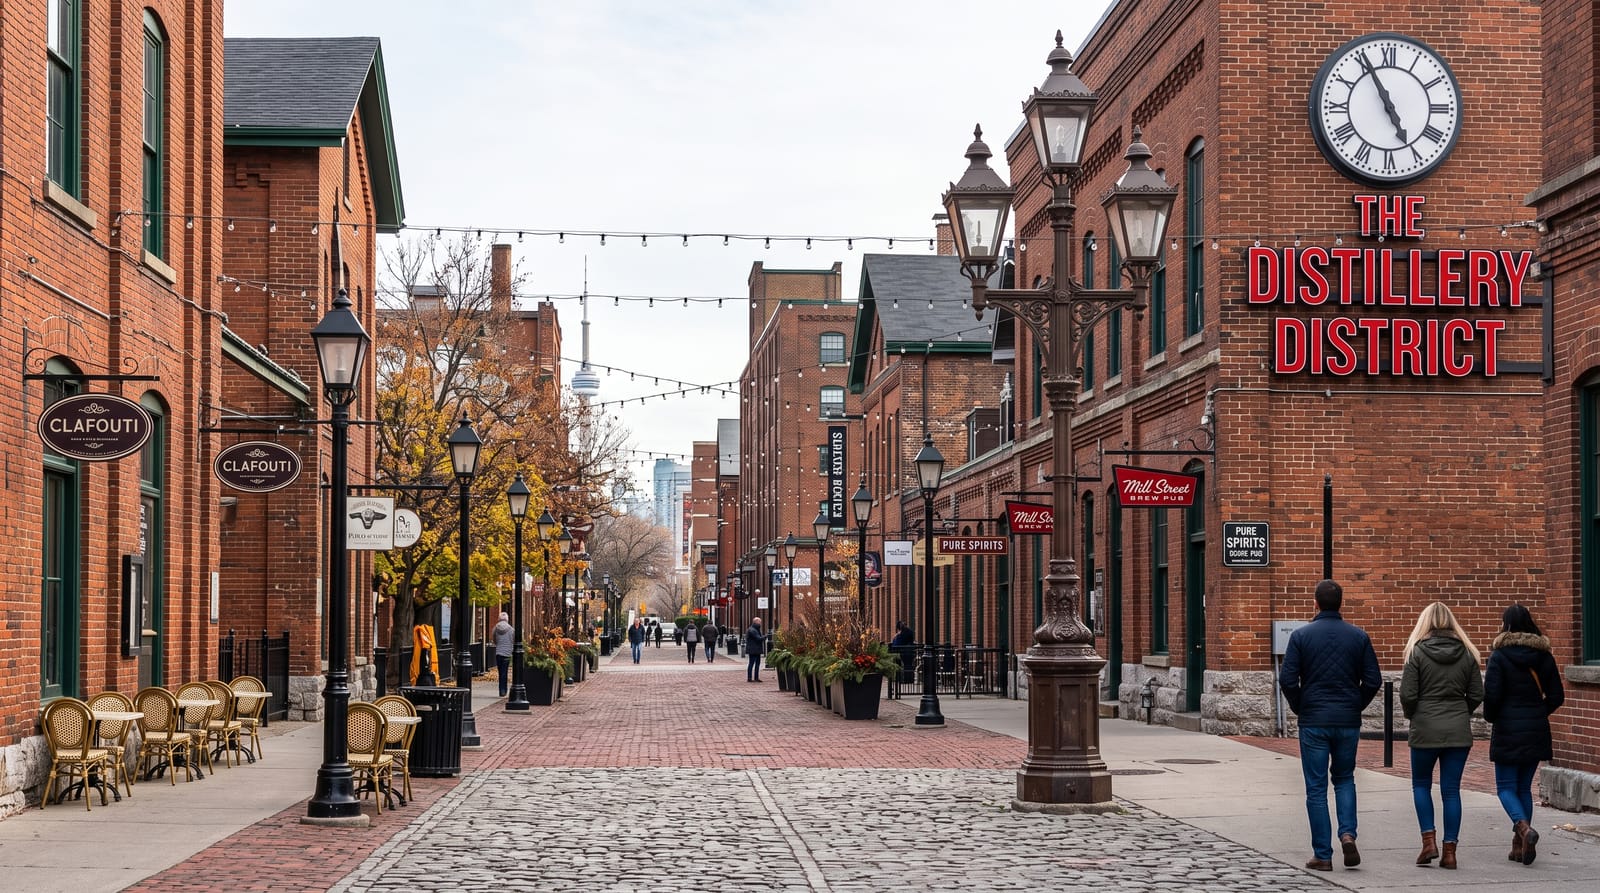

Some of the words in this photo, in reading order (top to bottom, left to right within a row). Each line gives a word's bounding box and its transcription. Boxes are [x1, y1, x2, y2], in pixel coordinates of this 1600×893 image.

[1381, 47, 1396, 67] XII
[1408, 55, 1420, 72] I
[1335, 74, 1355, 89] X
[1424, 76, 1442, 90] II
[1329, 101, 1348, 113] IX
[1430, 103, 1449, 114] III
[1334, 122, 1356, 146] VIII
[1354, 143, 1371, 164] VII
[1384, 150, 1396, 170] VI
[1410, 144, 1423, 163] V
[1354, 195, 1426, 237] THE
[1248, 246, 1532, 307] DISTILLERY
[1275, 317, 1506, 377] DISTRICT
[50, 418, 138, 433] CLAFOUTI
[223, 460, 291, 472] CLAFOUTI
[1123, 479, 1153, 494] Mill
[1153, 479, 1190, 494] Street
[1014, 511, 1038, 523] Mill
[1235, 526, 1257, 536] PURE
[943, 540, 966, 550] PURE
[968, 540, 1003, 550] SPIRITS
[1226, 537, 1266, 548] SPIRITS
